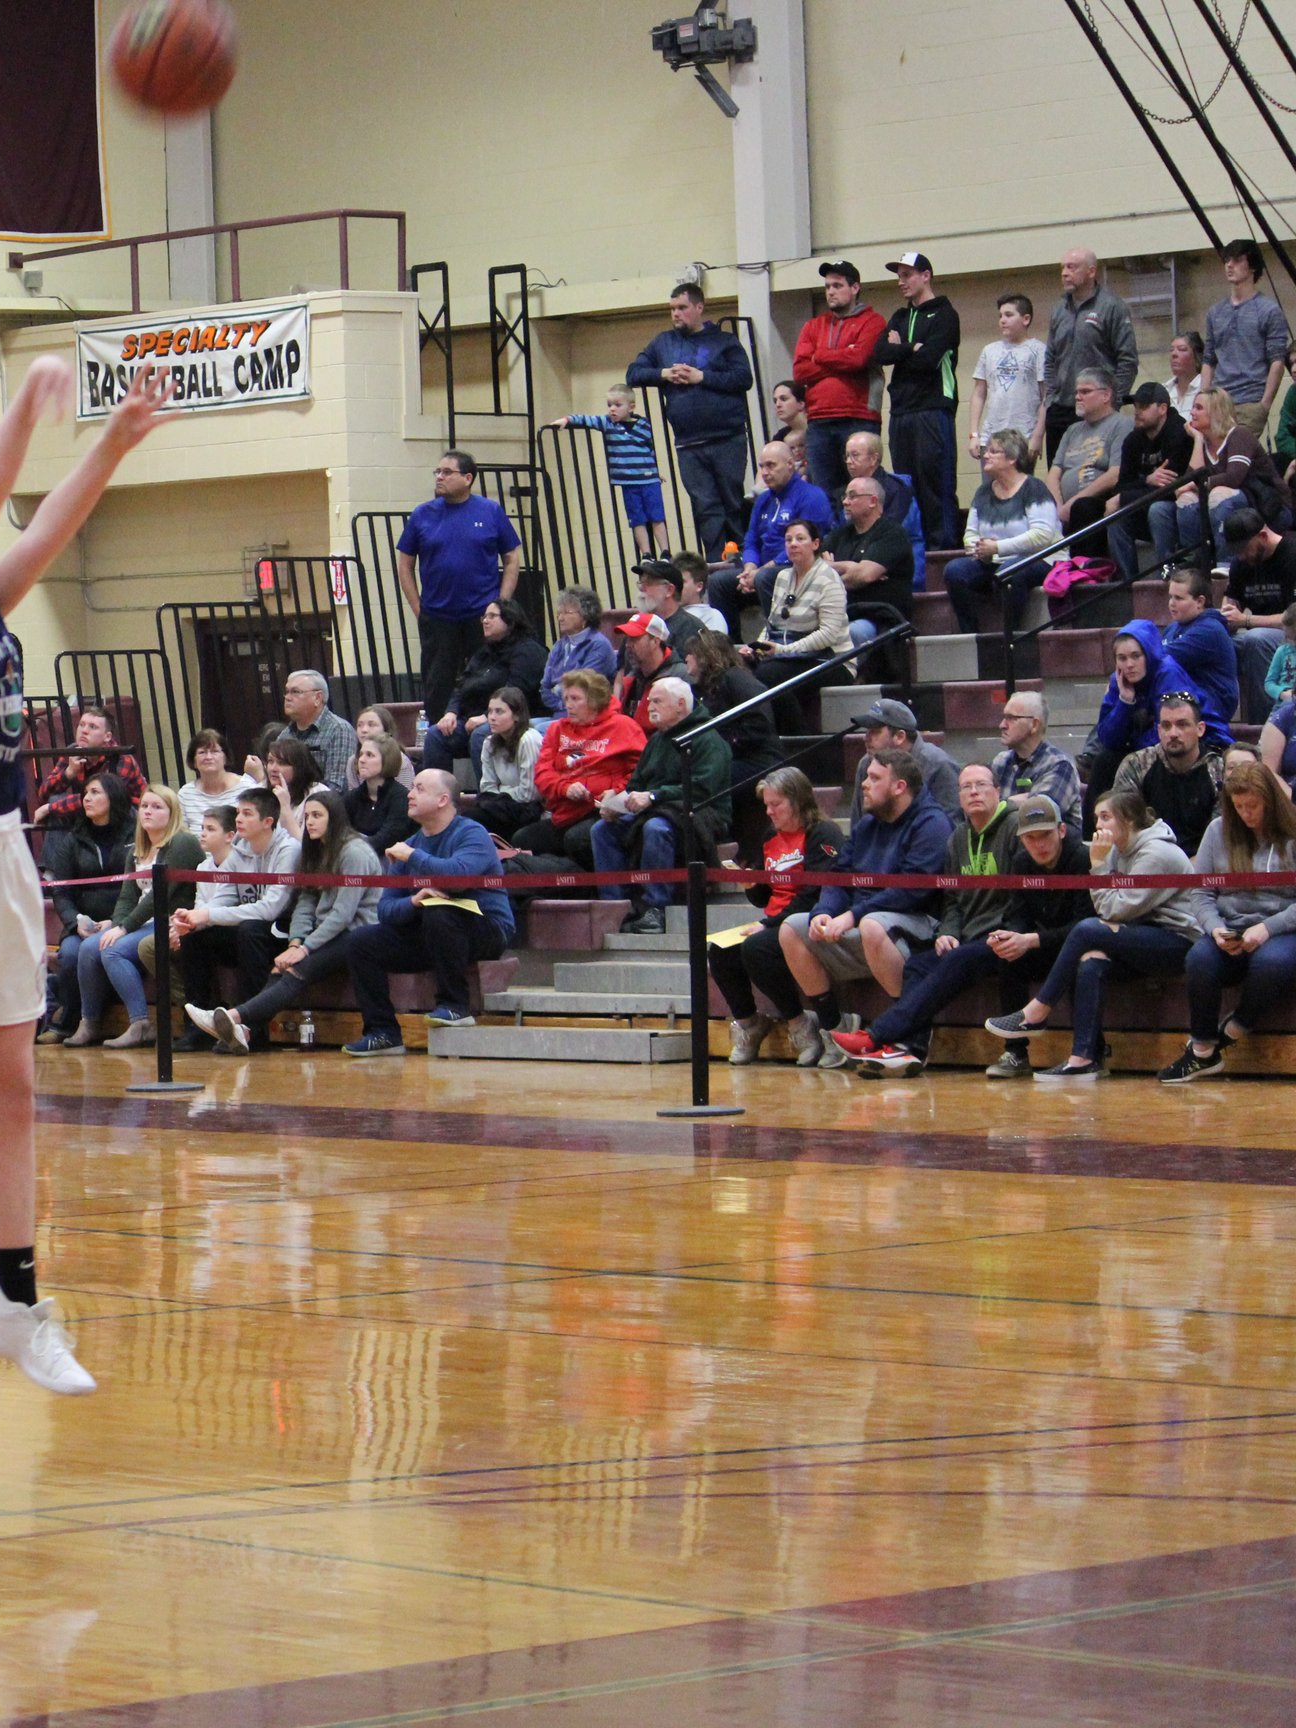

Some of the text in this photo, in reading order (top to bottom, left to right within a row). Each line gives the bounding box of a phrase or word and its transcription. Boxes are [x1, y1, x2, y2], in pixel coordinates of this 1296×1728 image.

[120, 319, 272, 362] SPECIALTY
[233, 338, 301, 394] CAMP
[560, 876, 575, 885] NHTI
[634, 873, 650, 882] NHTI
[774, 874, 791, 883] NHTI
[855, 876, 873, 885] NHTI
[1207, 877, 1226, 886] NHTI
[417, 878, 432, 887] NHTI
[488, 878, 503, 887] NHTI
[940, 878, 958, 887] NHTI
[1026, 878, 1045, 887] NHTI
[1115, 878, 1134, 887] NHTI
